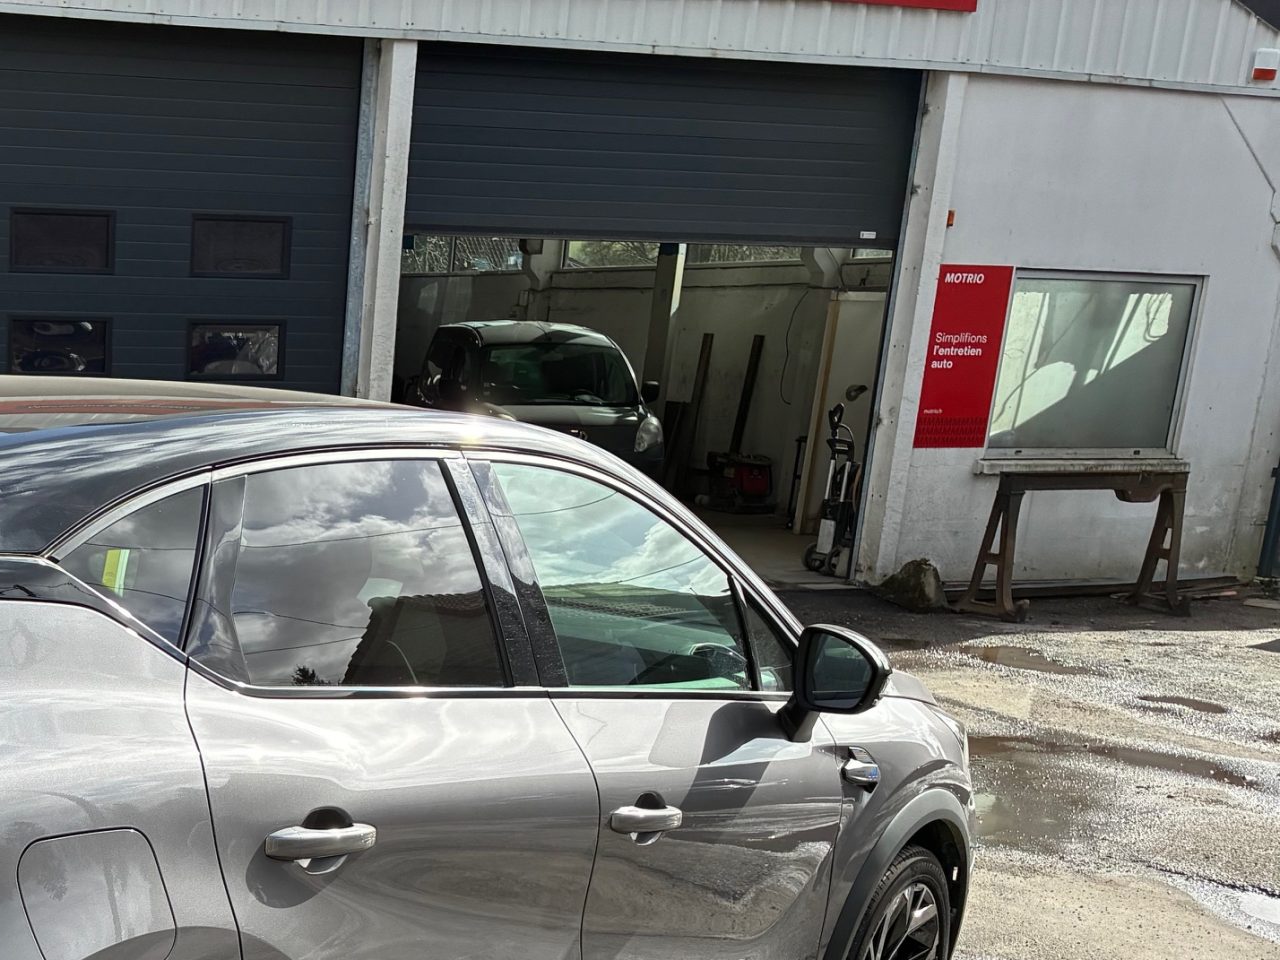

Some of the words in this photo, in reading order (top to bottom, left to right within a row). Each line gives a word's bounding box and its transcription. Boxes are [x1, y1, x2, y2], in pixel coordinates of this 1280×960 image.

[945, 272, 985, 284] MOTRIO
[935, 332, 988, 345] Simplifions
[933, 345, 982, 356] l'entretien
[931, 359, 953, 369] auto
